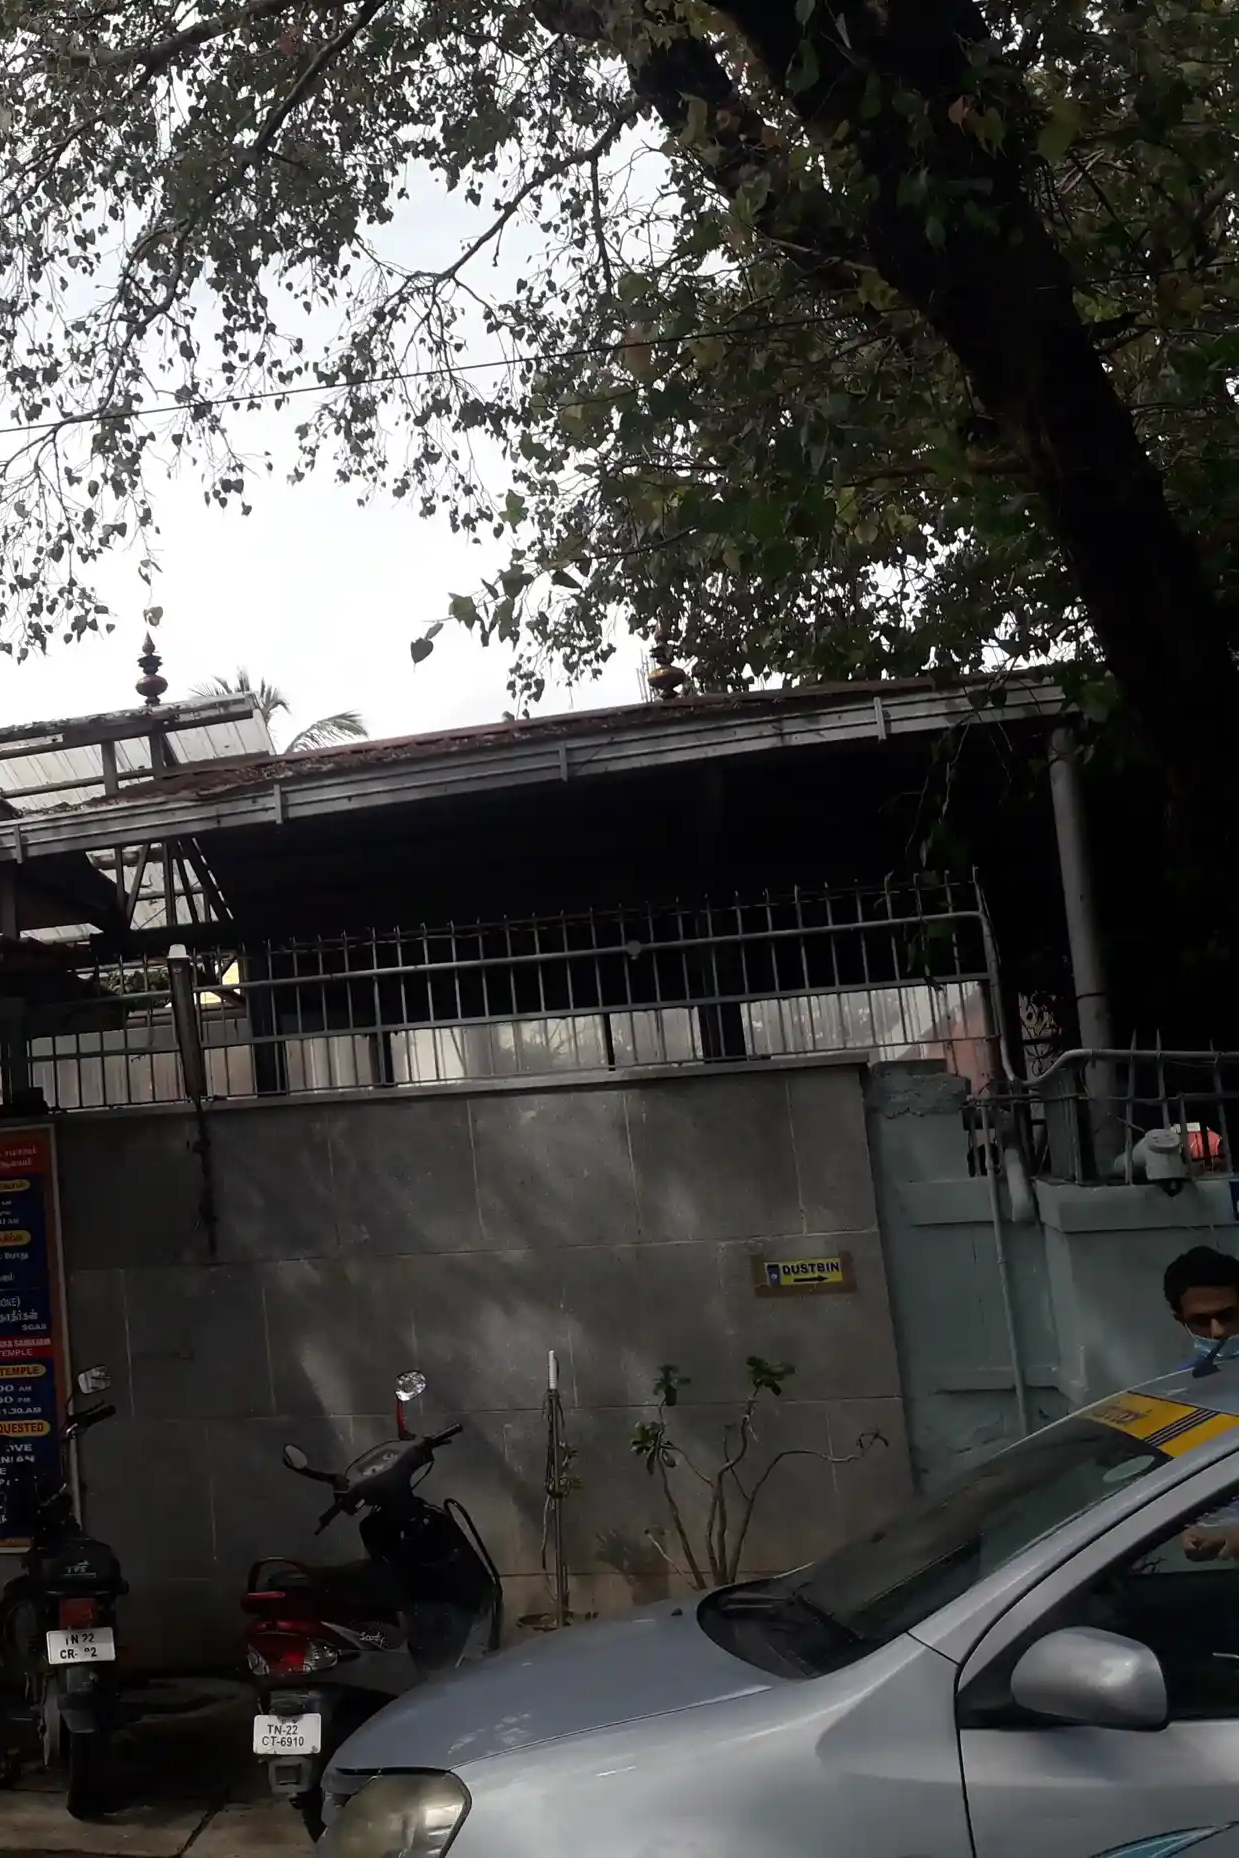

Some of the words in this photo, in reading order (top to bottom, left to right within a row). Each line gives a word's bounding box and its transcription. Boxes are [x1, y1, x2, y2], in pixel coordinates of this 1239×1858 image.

[782, 1262, 839, 1276] DUSTBIN
[0, 1365, 40, 1377] TEMPLE
[267, 1724, 299, 1736] TN-22
[261, 1735, 305, 1748] CT-6910
